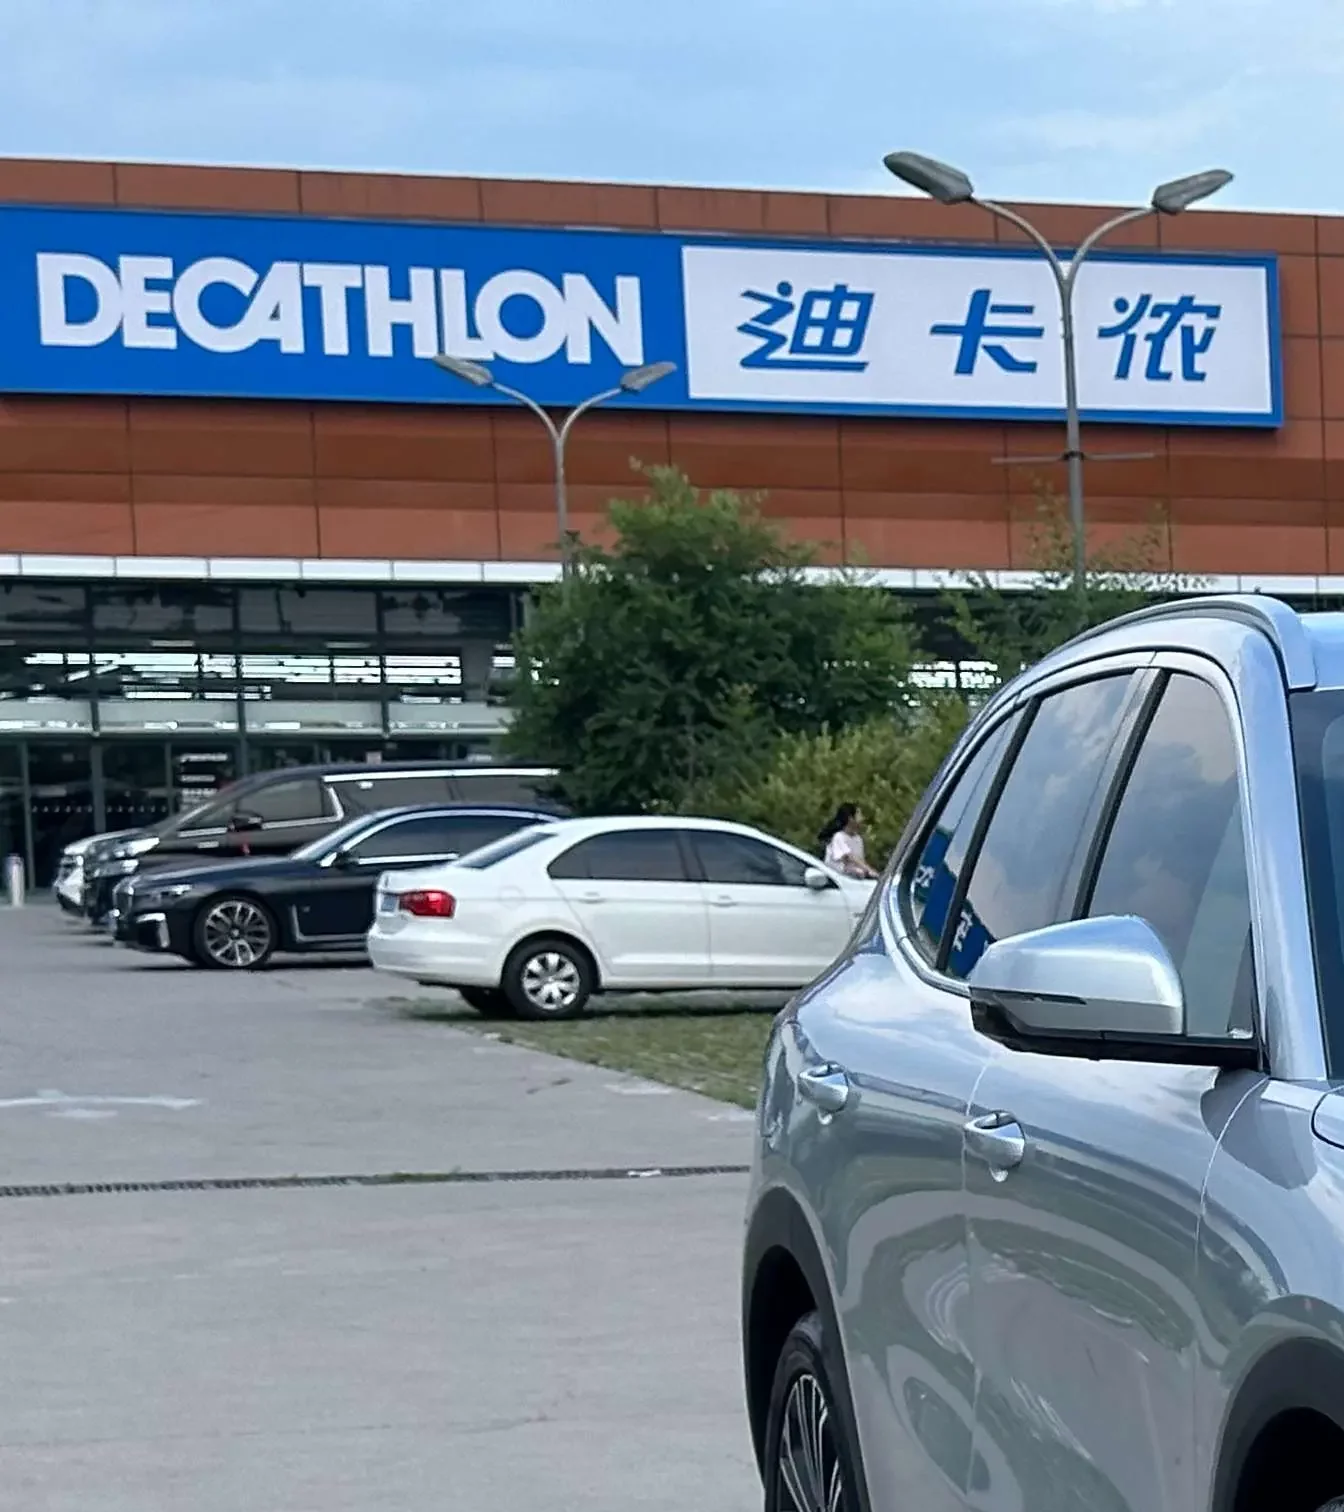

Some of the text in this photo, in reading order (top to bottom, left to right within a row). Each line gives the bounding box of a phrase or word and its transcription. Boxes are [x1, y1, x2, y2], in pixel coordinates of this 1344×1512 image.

[35, 251, 645, 367] DECATHLON
[736, 281, 1222, 382] 迪卡侬
